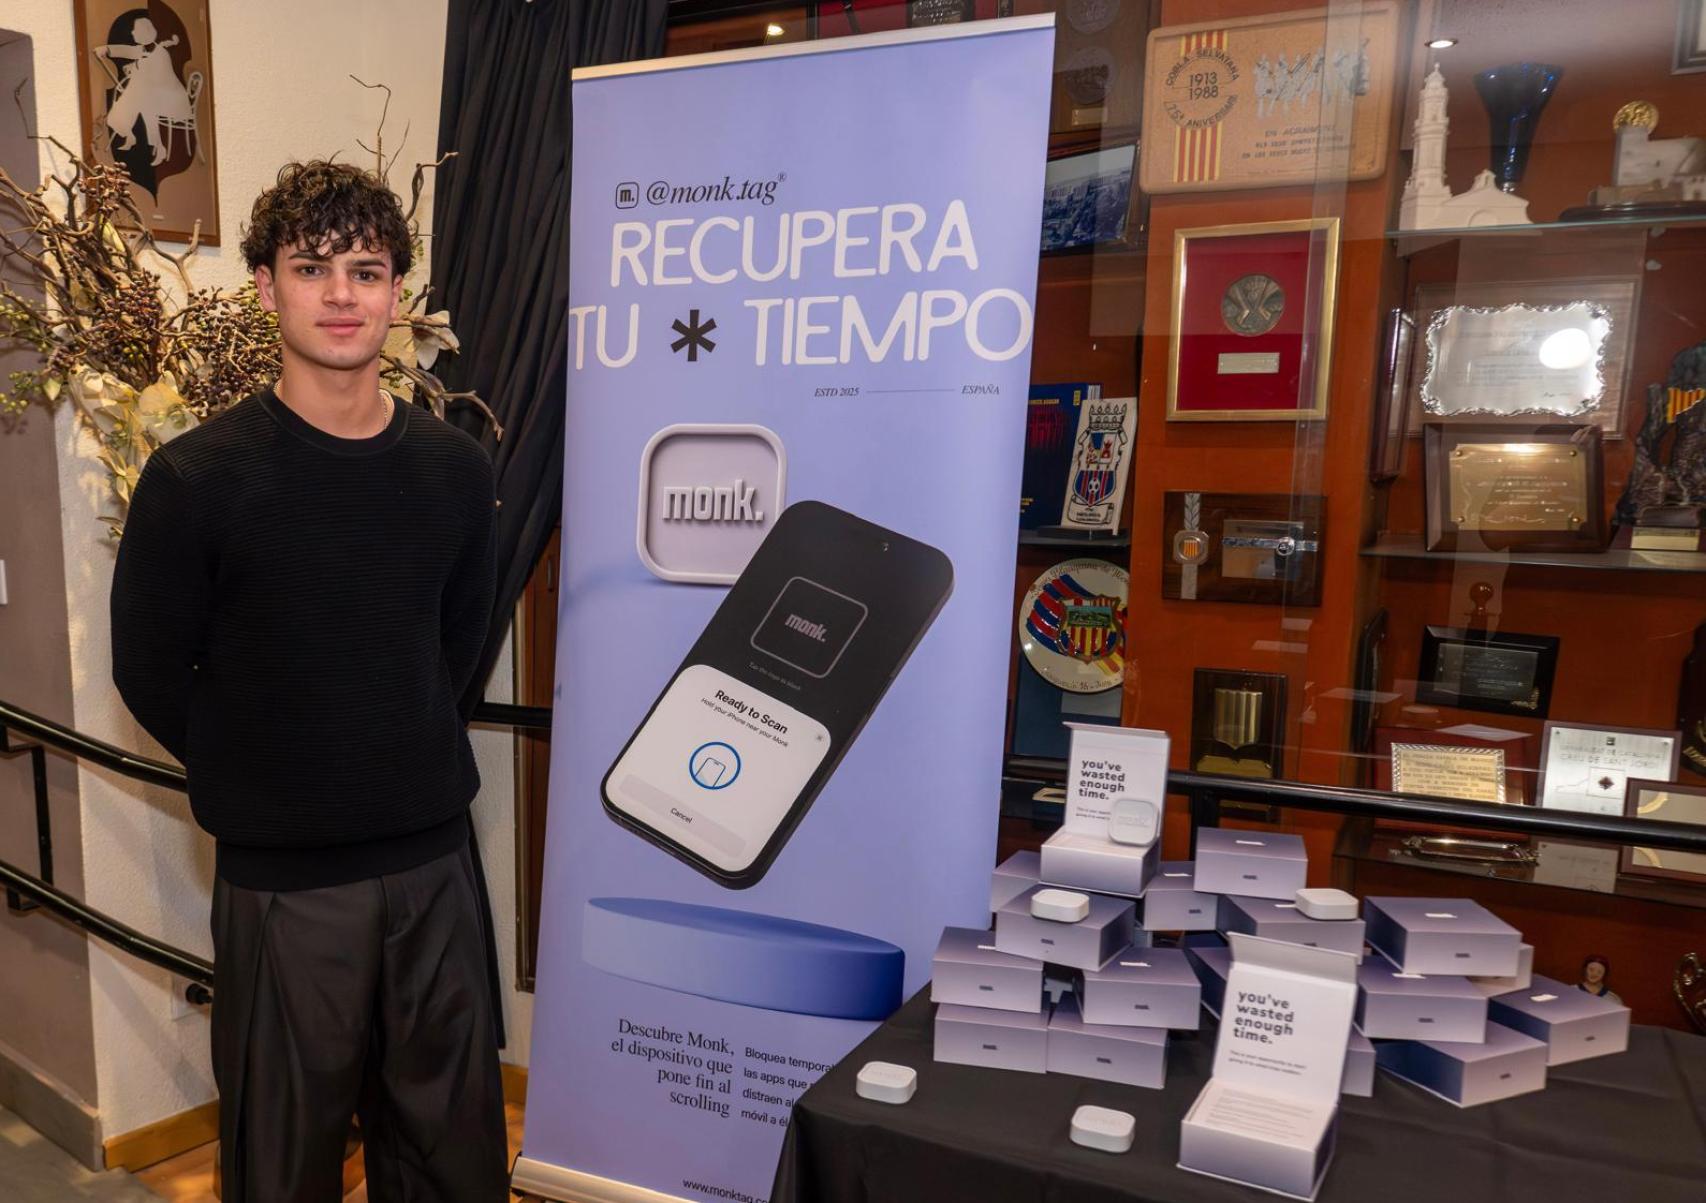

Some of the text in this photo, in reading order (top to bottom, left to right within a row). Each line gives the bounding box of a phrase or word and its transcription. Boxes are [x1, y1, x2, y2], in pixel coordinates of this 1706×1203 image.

[1189, 71, 1218, 88] 1913
[1189, 85, 1219, 100] 1988
[610, 199, 979, 288] RECUPERA
[568, 288, 1033, 370] TU TIEMPO
[814, 383, 1000, 397] ESTD 2025 ESPAÑA
[662, 478, 765, 522] monk.
[784, 613, 827, 642] monk.
[714, 689, 788, 734] Ready to Scan
[714, 706, 727, 715] your
[746, 722, 759, 731] near
[759, 730, 773, 739] your
[1081, 759, 1122, 772] you've
[1080, 770, 1126, 782] wasted
[1078, 788, 1110, 800] time.
[1079, 779, 1125, 793] enough
[670, 807, 693, 824] Cancel
[1238, 990, 1290, 1009] you've
[1236, 1003, 1295, 1023] wasted
[1233, 1027, 1273, 1044] time.
[1234, 1016, 1294, 1036] enough
[618, 1018, 735, 1056] Descubre Monk,
[611, 1038, 733, 1075] el dispositivo que
[745, 1047, 786, 1064] Bloquea
[657, 1067, 731, 1094] pone fin al
[743, 1067, 808, 1089] las apps que
[669, 1089, 731, 1118] scrolling
[742, 1088, 783, 1105] distraen
[740, 1110, 768, 1123] móvil
[770, 1117, 777, 1125] a
